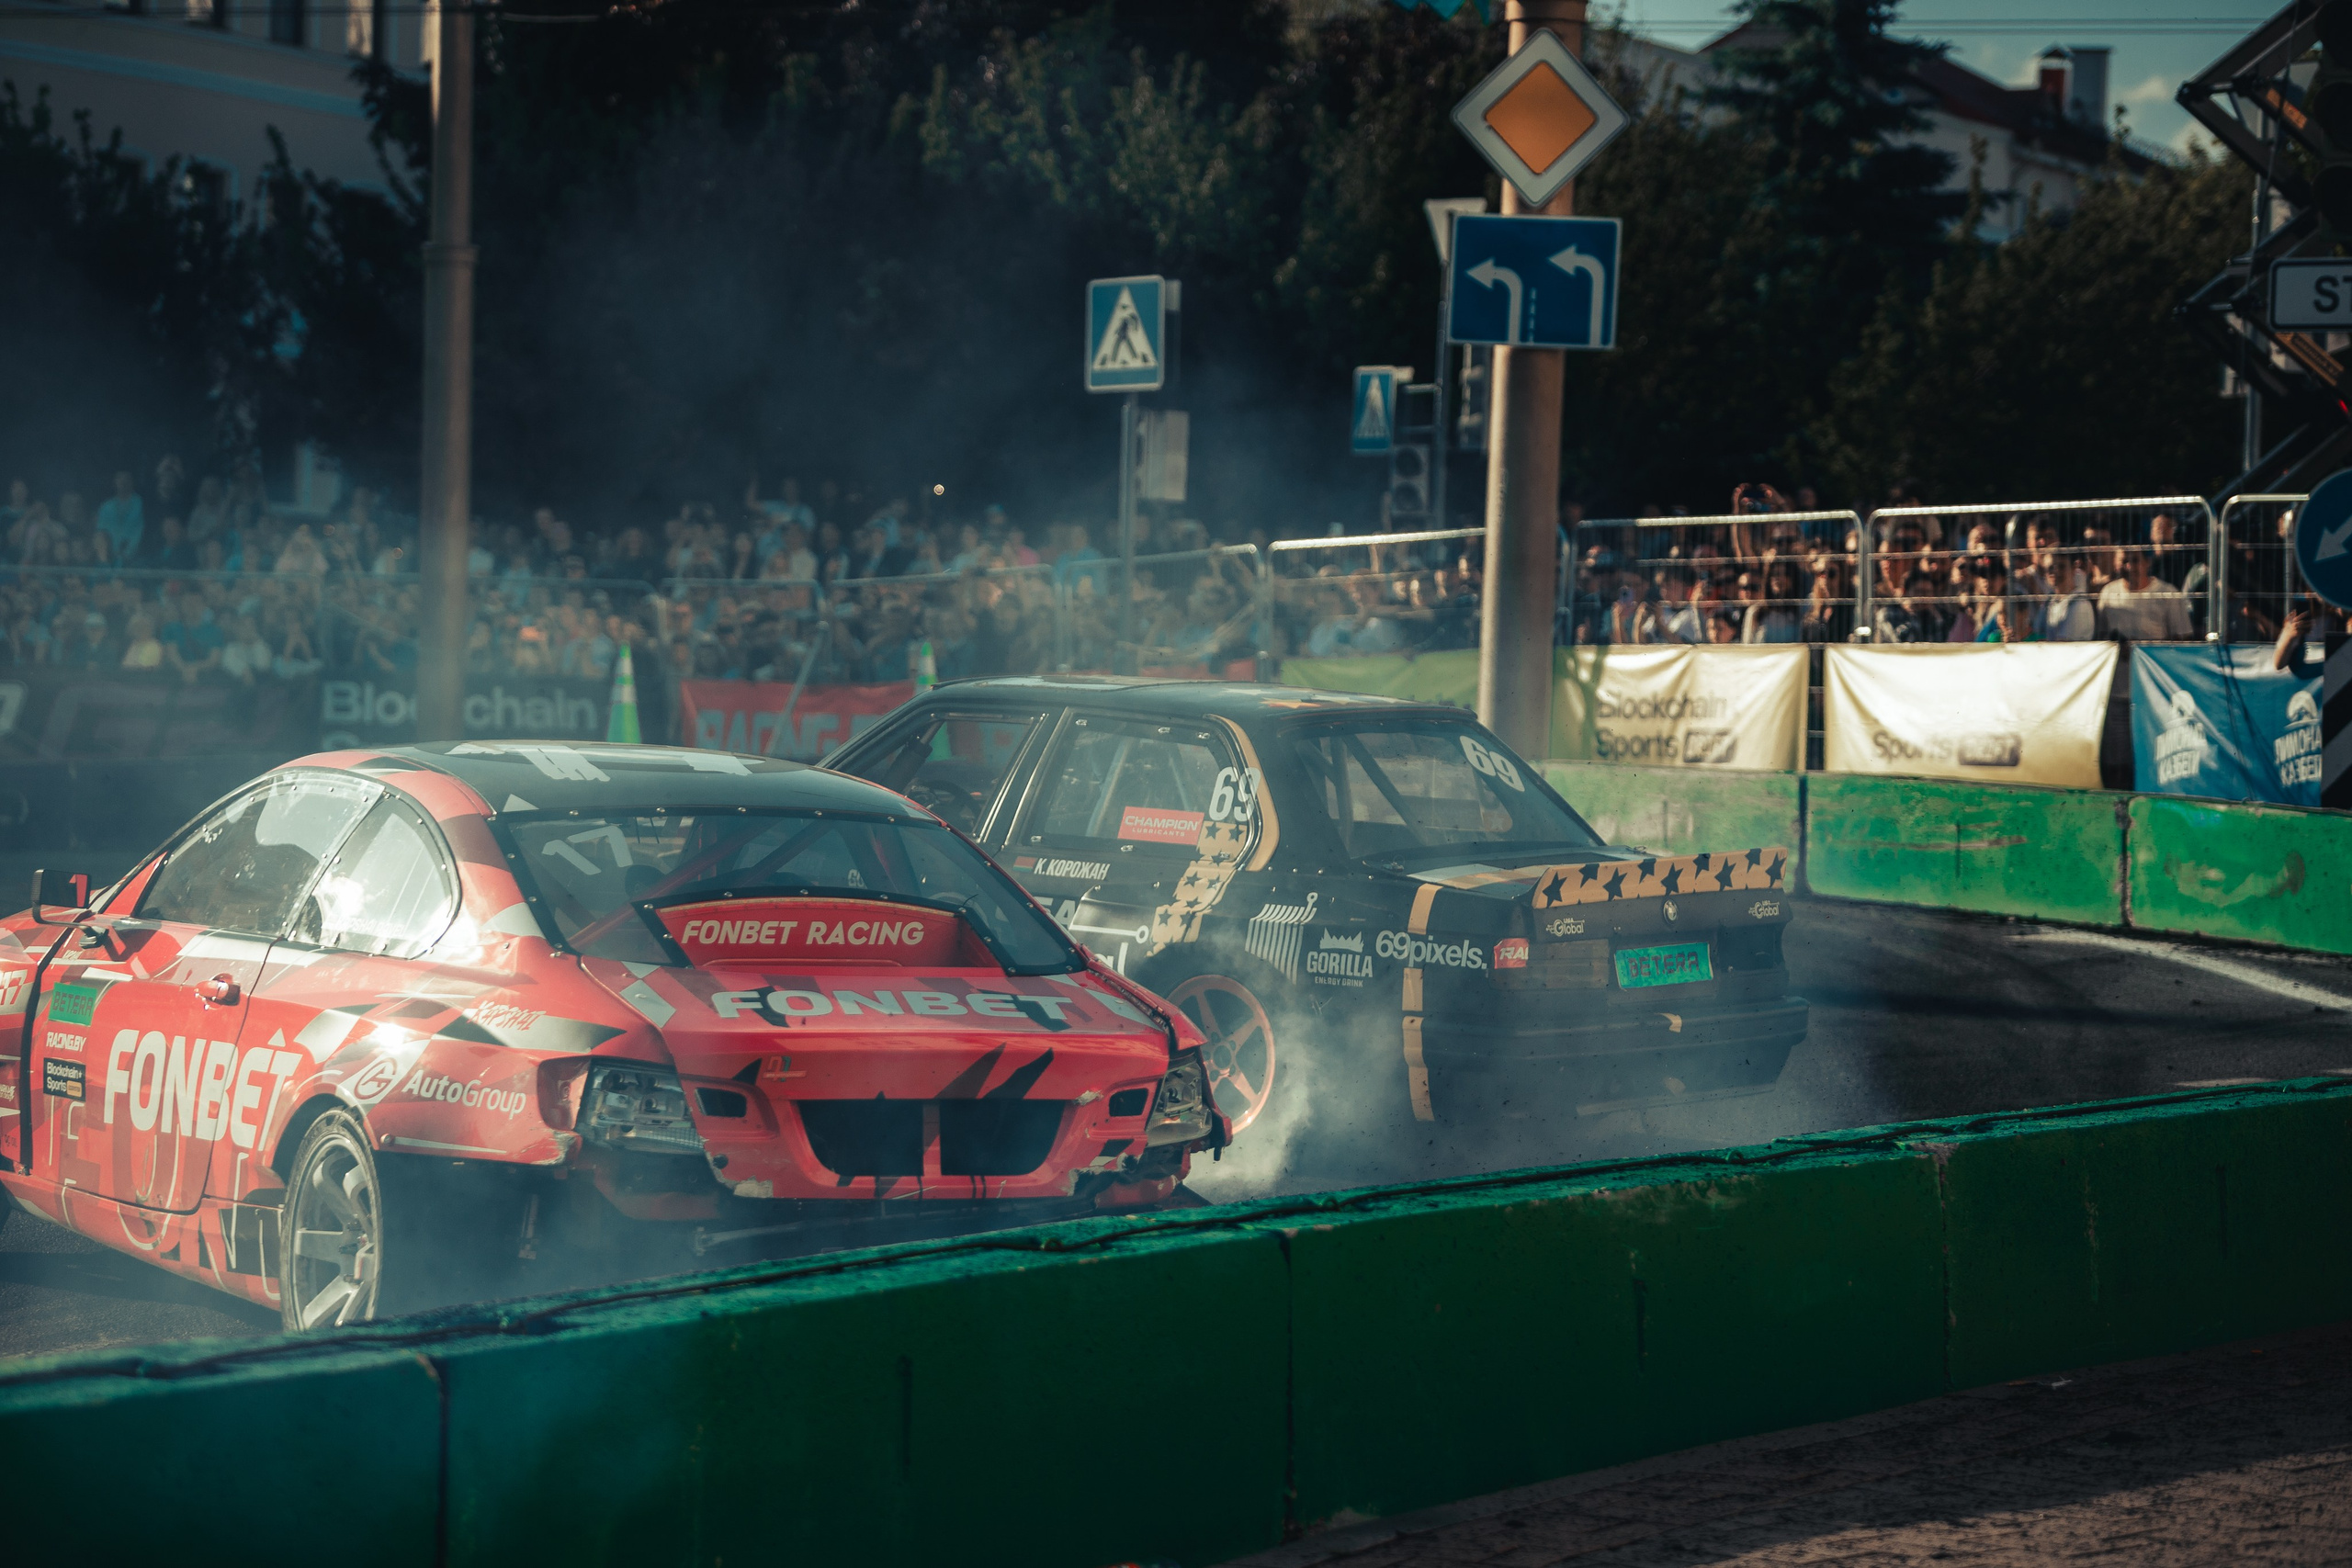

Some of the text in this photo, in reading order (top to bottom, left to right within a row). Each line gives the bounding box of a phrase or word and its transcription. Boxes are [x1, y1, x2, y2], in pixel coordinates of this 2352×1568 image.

[1597, 728, 1679, 761] Sports
[1459, 736, 1525, 793] 69
[1209, 767, 1261, 821] 69
[1125, 815, 1197, 831] CHAMPION
[1132, 828, 1185, 837] LUBRICANTS
[681, 919, 924, 945] FONBET RACING
[1306, 951, 1373, 977] GORILLA
[1375, 930, 1487, 970] 69pixels.
[1315, 976, 1363, 987] ENERGY DRINK
[711, 989, 1073, 1020] FONBET
[47, 1076, 67, 1092] Sports
[103, 1028, 304, 1152] FONBET
[401, 1070, 526, 1120] AutoGroup
